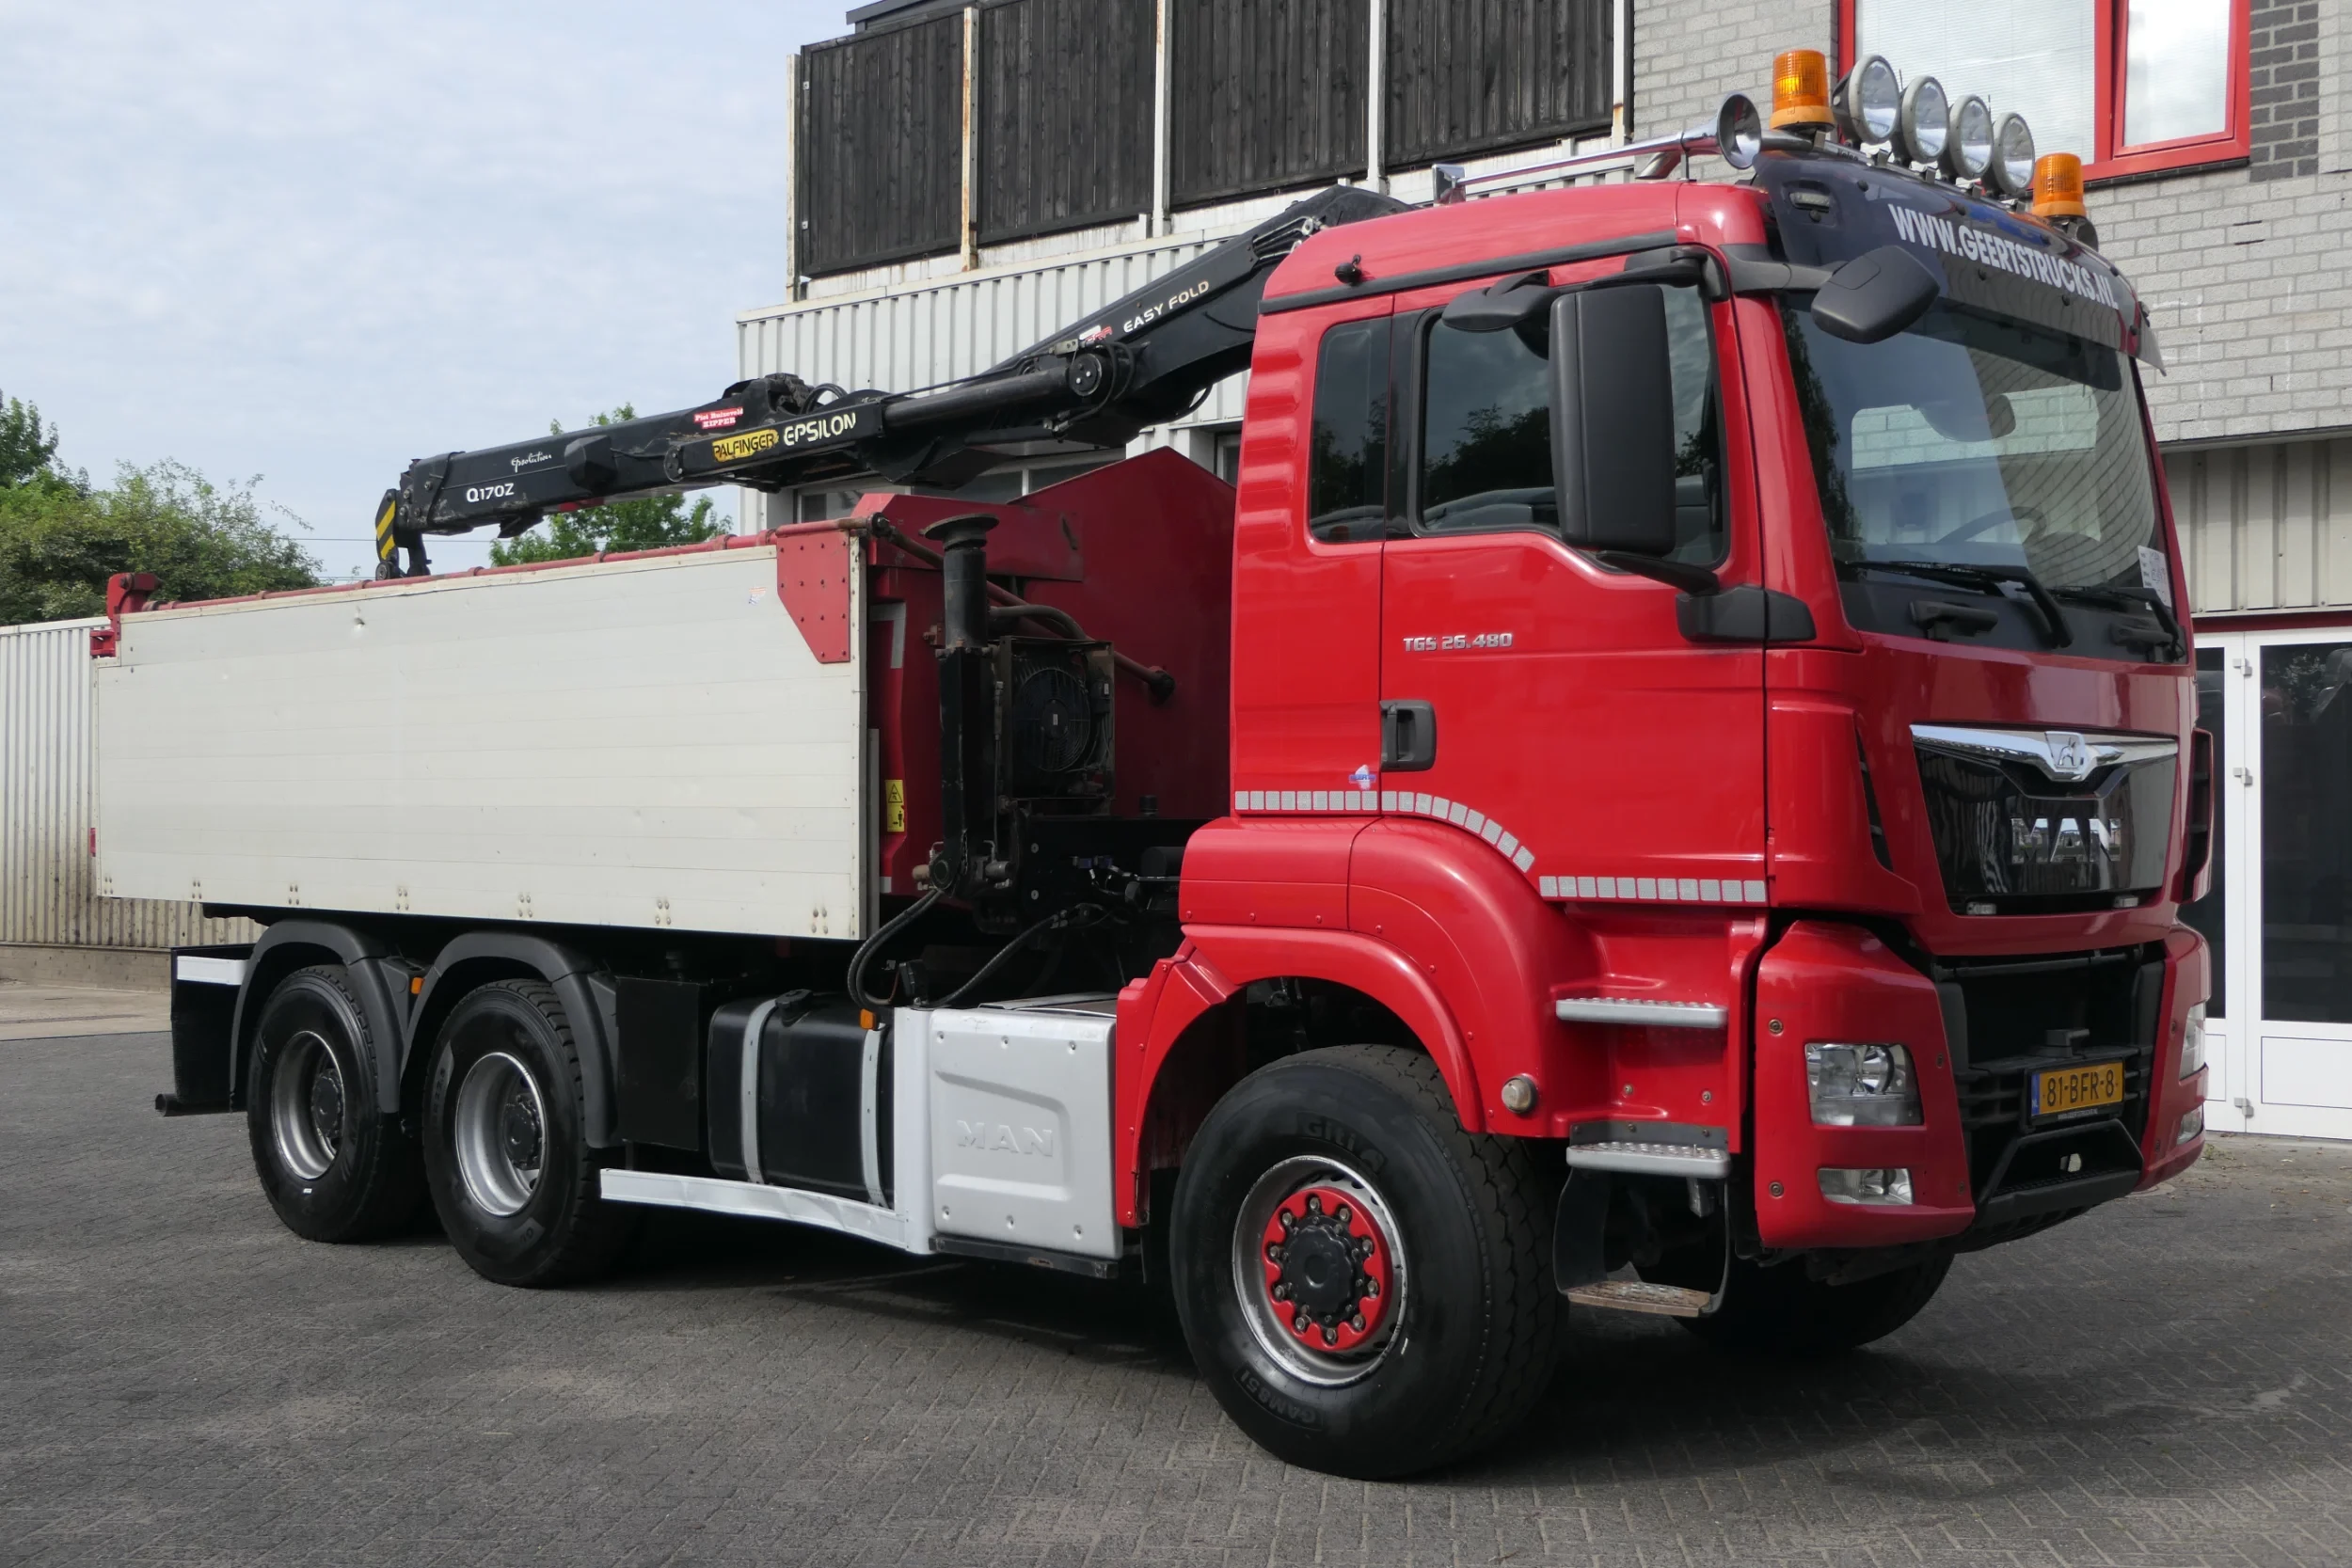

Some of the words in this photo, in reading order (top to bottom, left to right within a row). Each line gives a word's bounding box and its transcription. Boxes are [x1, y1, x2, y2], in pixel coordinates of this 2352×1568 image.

[1888, 204, 2119, 309] WWW.GEERTSTRUCKS.NL
[1123, 304, 1164, 333] EASY
[1168, 281, 1210, 309] FOLD
[714, 433, 775, 458] PALFINGER
[784, 412, 856, 447] EPSILON
[467, 483, 515, 503] Q170Z
[1403, 636, 1438, 652] TGS
[1441, 632, 1513, 650] 26.480
[2010, 817, 2122, 863] MAN
[2046, 1069, 2115, 1107] 81-BFR-8
[957, 1119, 1054, 1157] MAN
